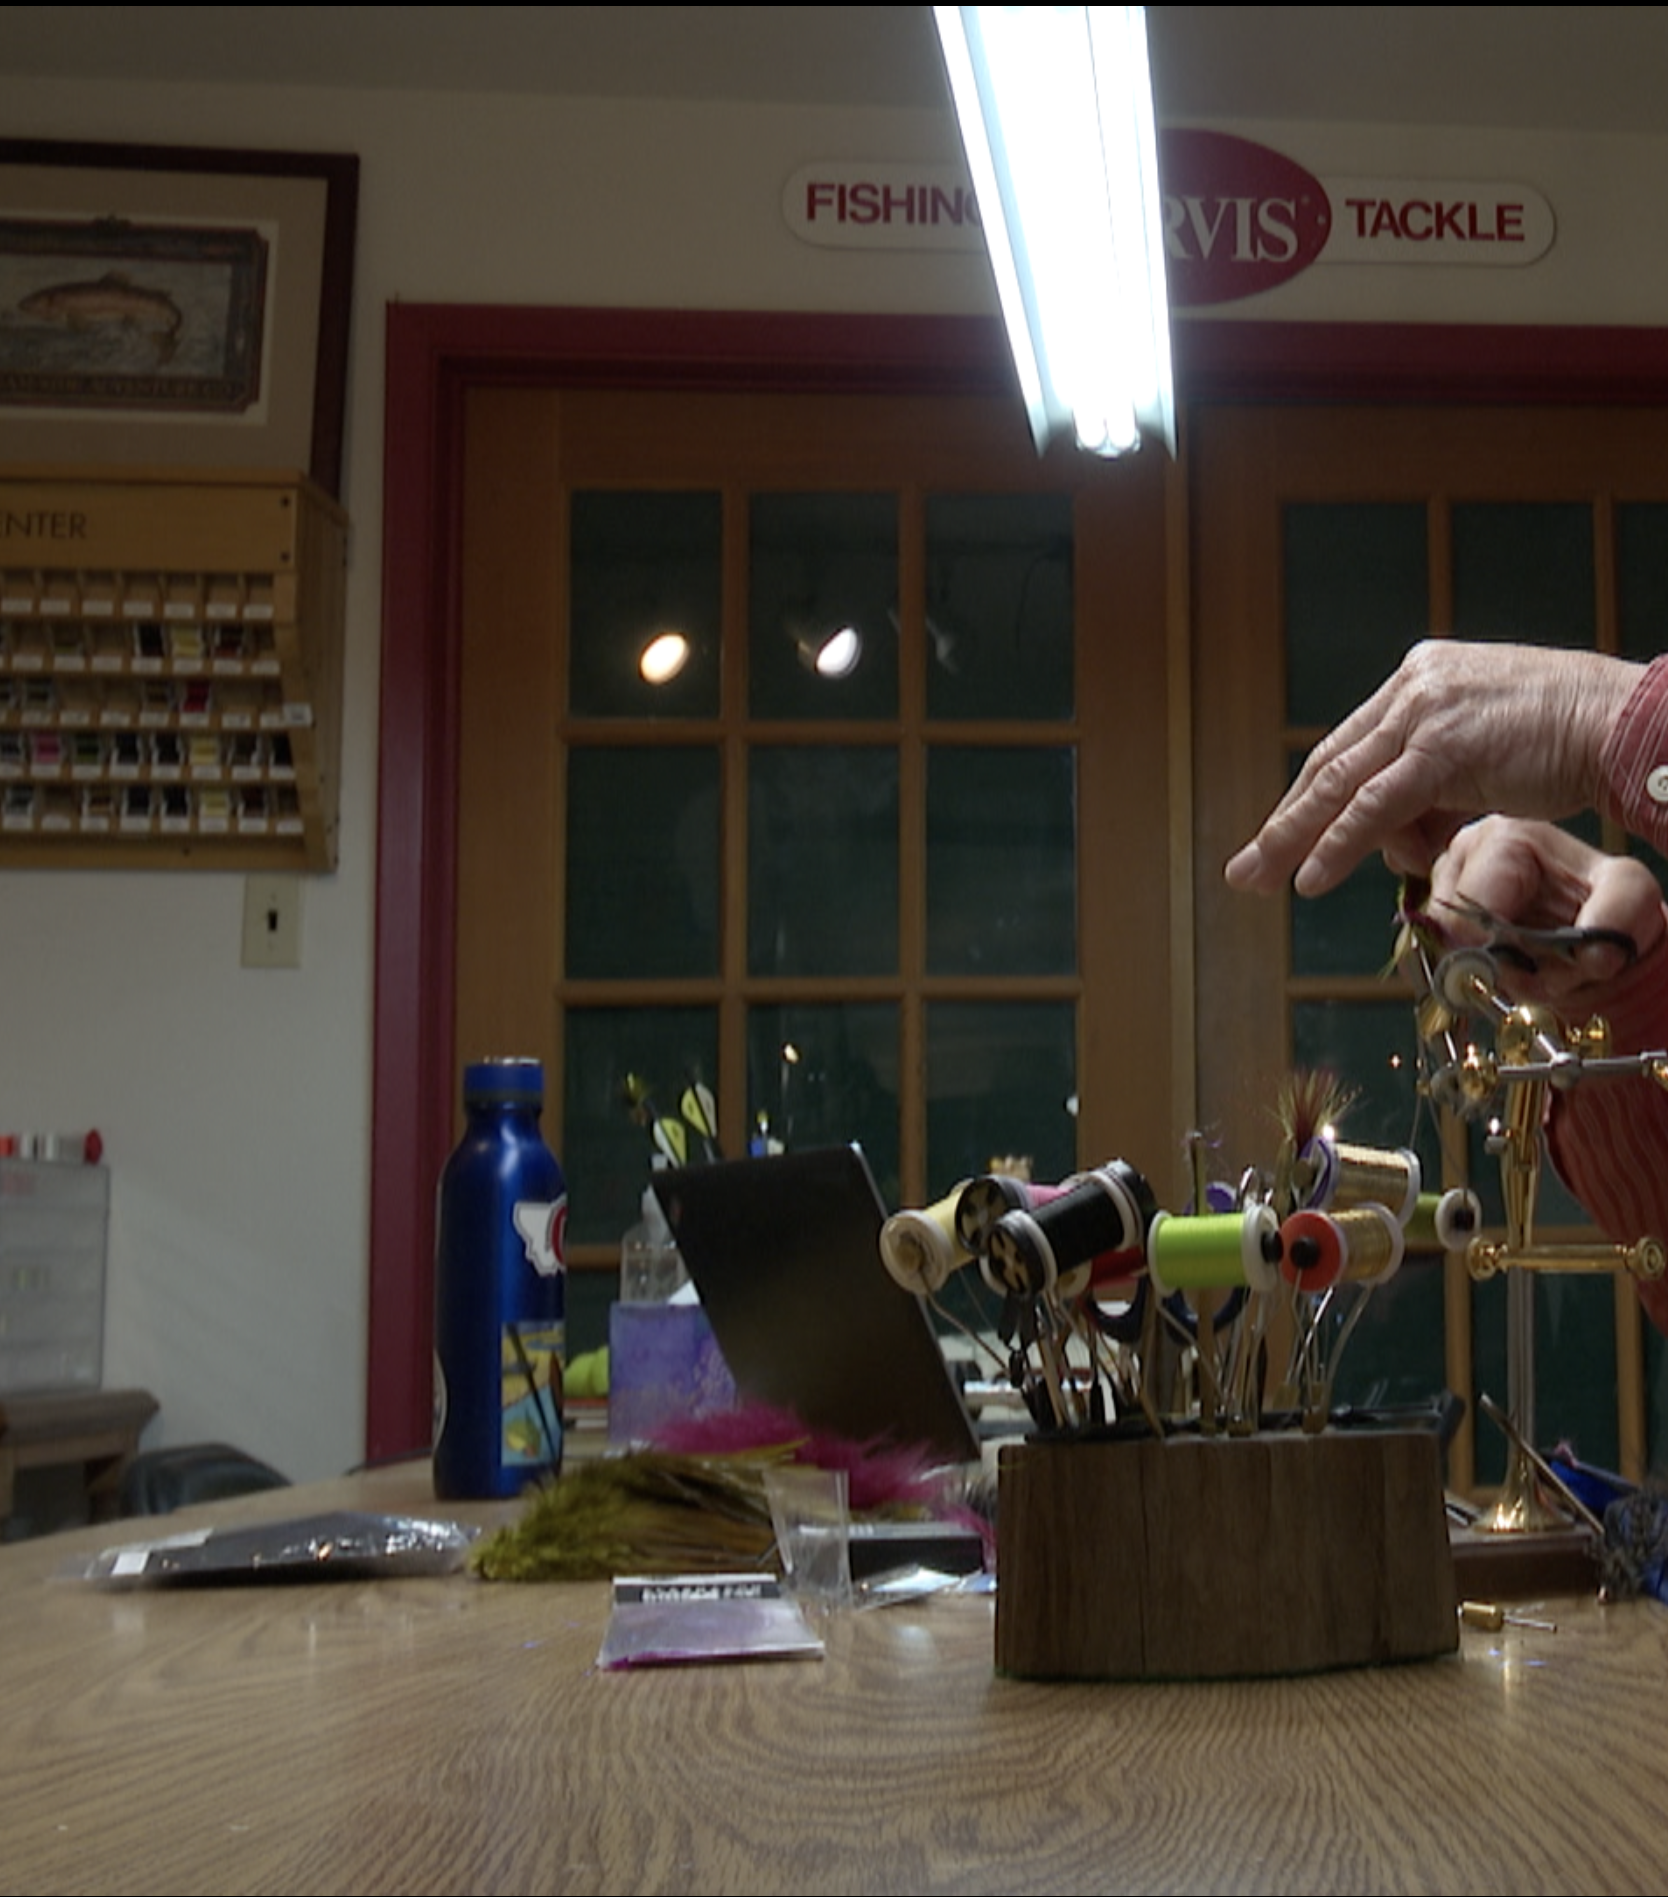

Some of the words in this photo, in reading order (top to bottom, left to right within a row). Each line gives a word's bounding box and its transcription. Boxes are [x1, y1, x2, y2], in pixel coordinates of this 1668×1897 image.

[1162, 194, 1299, 263] RVIS
[1345, 198, 1525, 242] TACKLE
[0, 509, 87, 539] NTER
